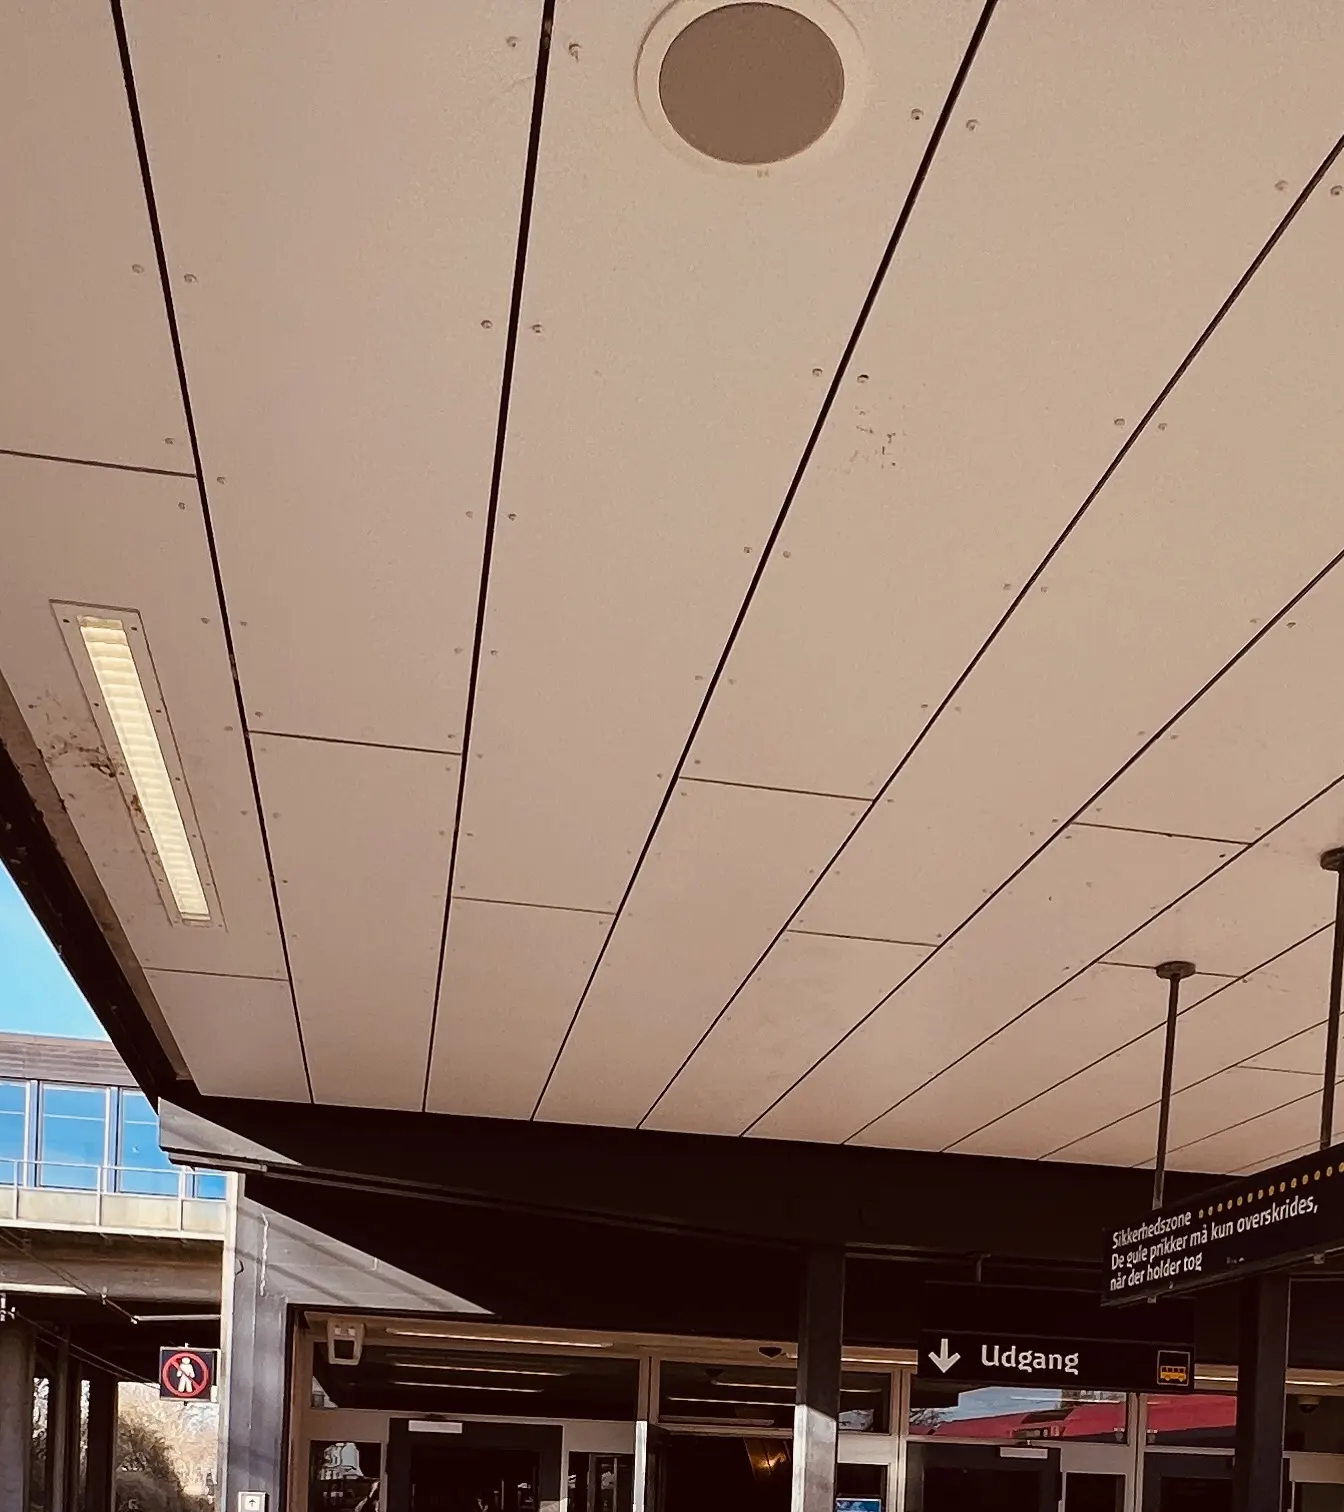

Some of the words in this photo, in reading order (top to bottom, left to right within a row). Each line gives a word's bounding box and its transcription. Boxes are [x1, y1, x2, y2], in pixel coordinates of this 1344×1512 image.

[1111, 1252, 1125, 1270] De
[1126, 1244, 1148, 1269] gule
[1149, 1234, 1187, 1264] prikker
[1190, 1224, 1208, 1247] må
[1211, 1220, 1234, 1241] kun
[1237, 1194, 1318, 1232] overskrides,
[1112, 1210, 1192, 1249] Sikkerhedszone
[1110, 1270, 1126, 1291] når
[1128, 1266, 1145, 1286] der
[1147, 1259, 1181, 1281] holder
[1184, 1252, 1202, 1271] tog
[981, 1344, 1079, 1375] Udgang
